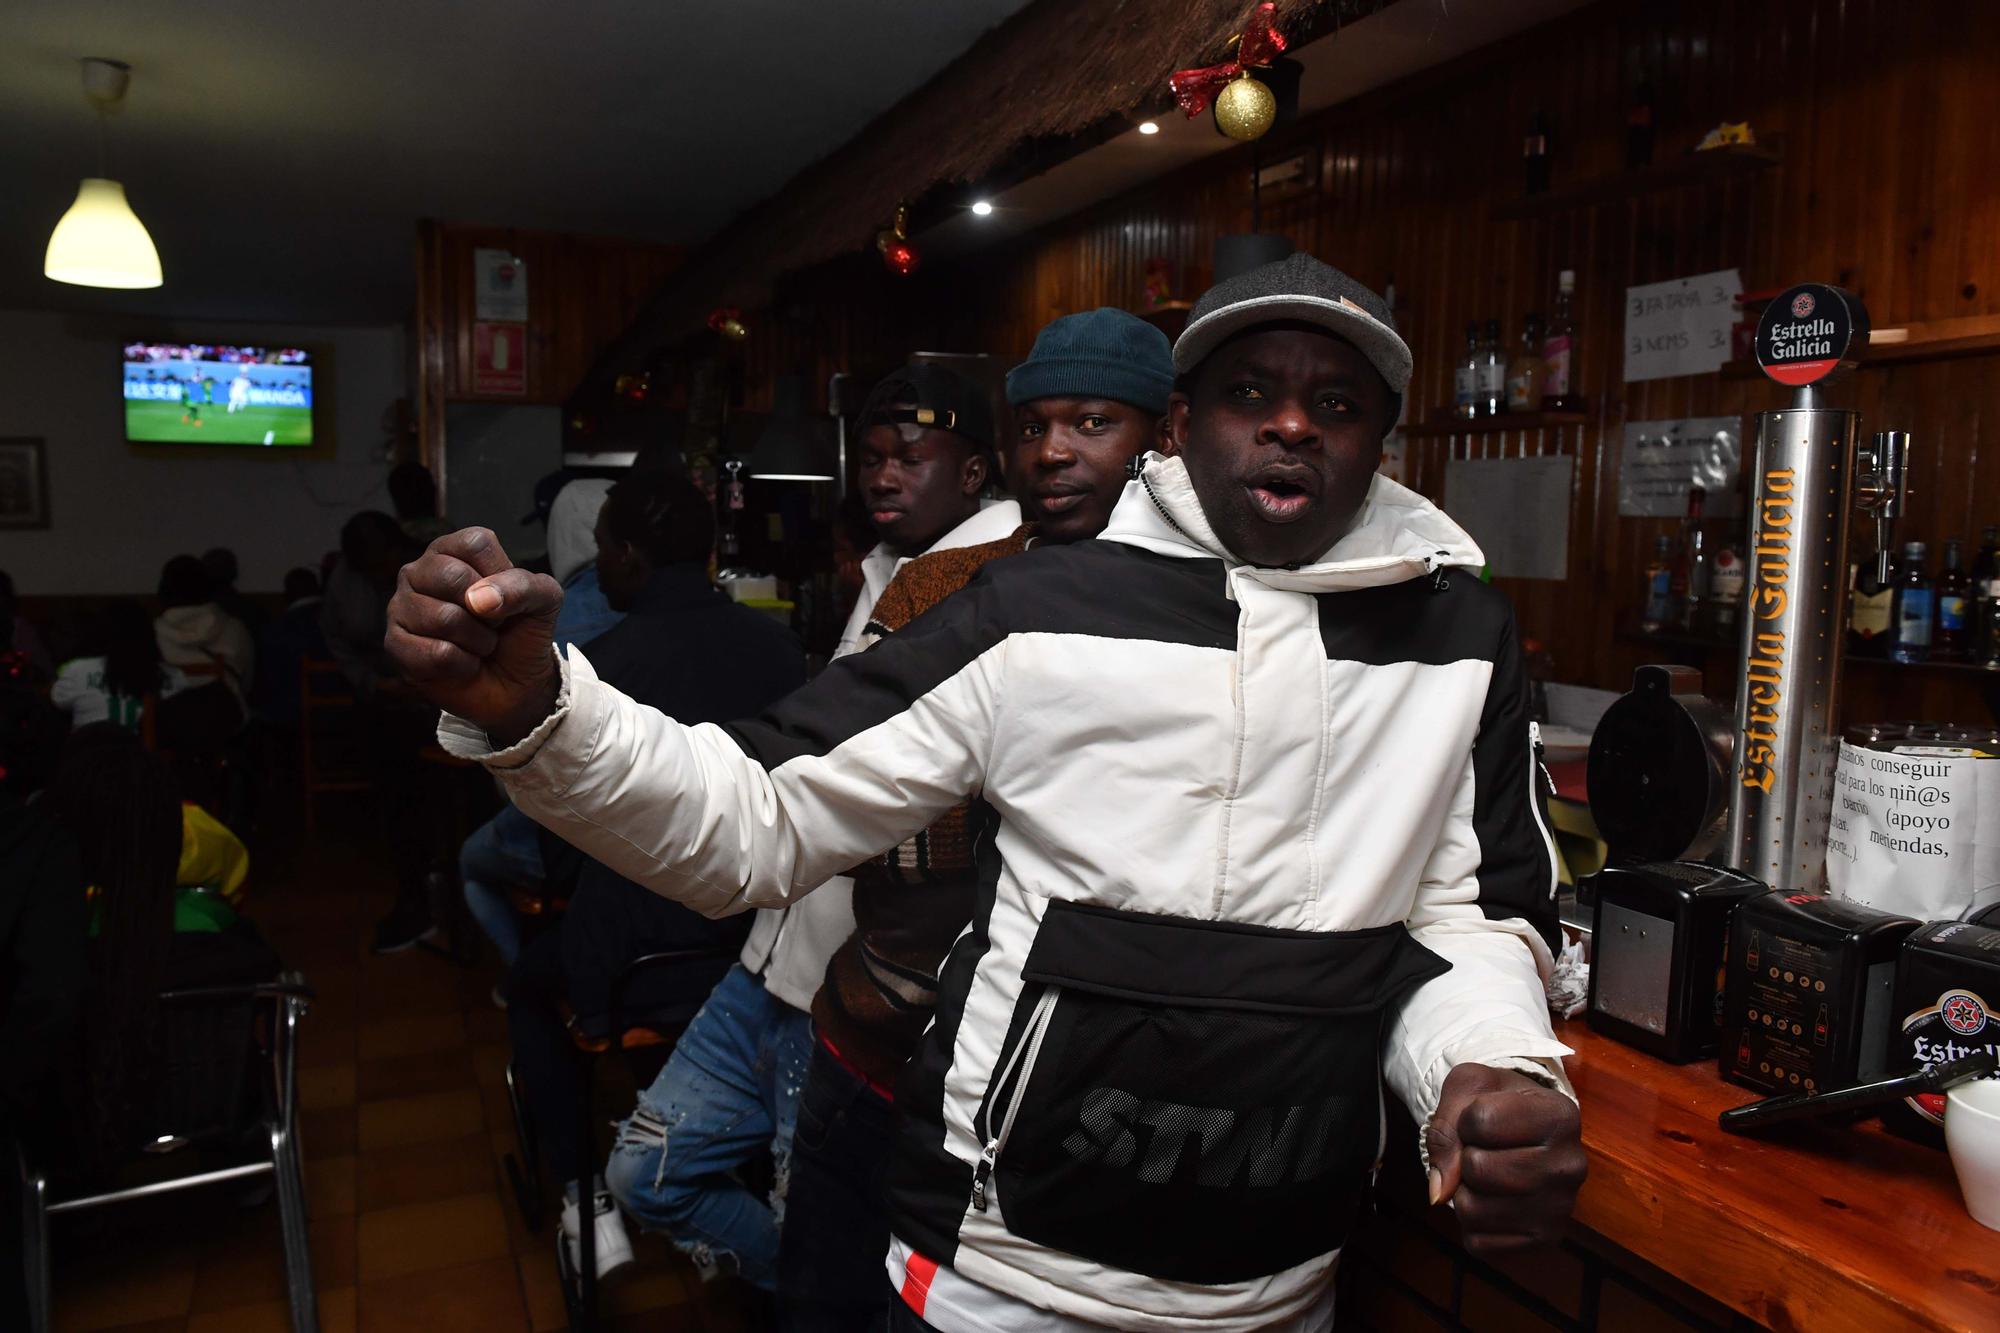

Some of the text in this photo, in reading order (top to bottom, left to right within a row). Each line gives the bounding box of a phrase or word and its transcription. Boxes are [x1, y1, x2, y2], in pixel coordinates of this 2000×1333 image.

[1769, 318, 1835, 341] Estrella
[1771, 337, 1831, 360] Galicia
[1738, 466, 1796, 795] Estrella Galicia
[1871, 758, 1951, 780] conseguir
[1848, 776, 1866, 792] para
[1869, 777, 1885, 797] los
[1890, 784, 1951, 806] niñ@s
[1886, 808, 1950, 833] (apoyo
[1869, 830, 1949, 859] meriendas,
